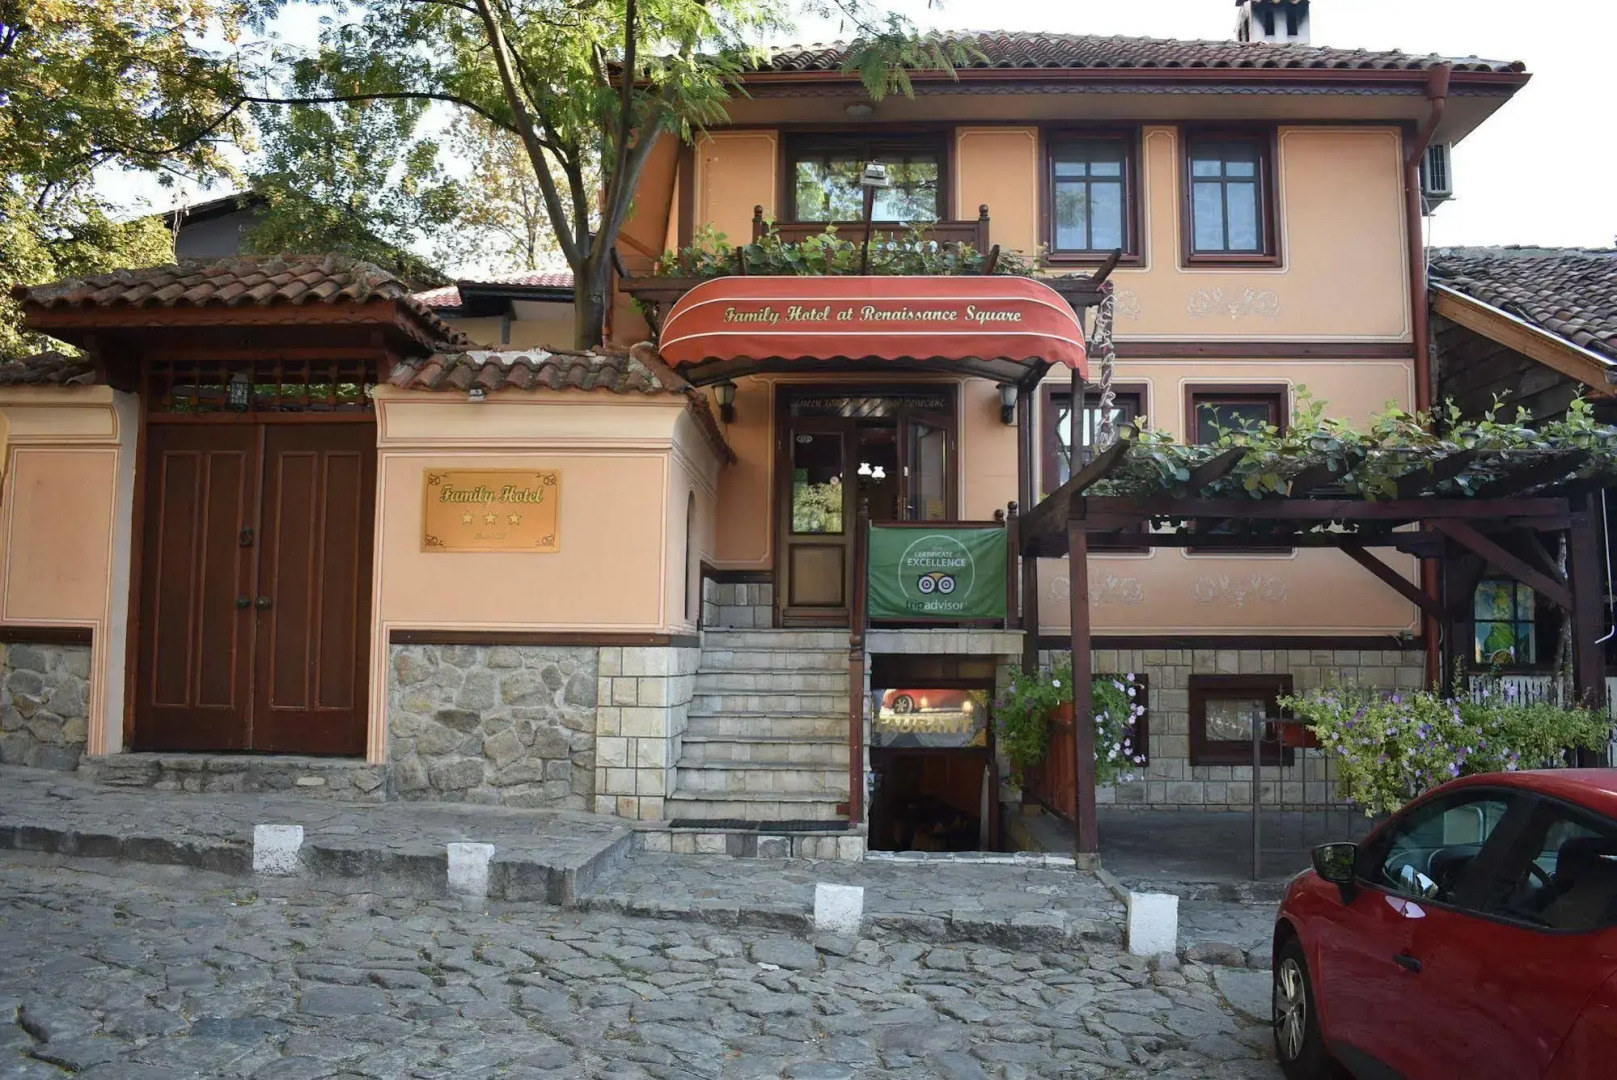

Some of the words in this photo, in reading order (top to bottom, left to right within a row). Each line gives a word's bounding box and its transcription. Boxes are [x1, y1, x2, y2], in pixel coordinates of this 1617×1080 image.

[723, 306, 780, 325] Family
[785, 305, 831, 321] Hotel
[836, 307, 854, 321] at
[859, 304, 958, 321] Renaissance
[964, 304, 1022, 325] Square
[440, 483, 495, 507] Family
[499, 484, 544, 504] Hotel
[907, 558, 967, 567] EXCELLENCE
[906, 600, 965, 612] tripadvisor
[874, 716, 975, 734] TAURANT
